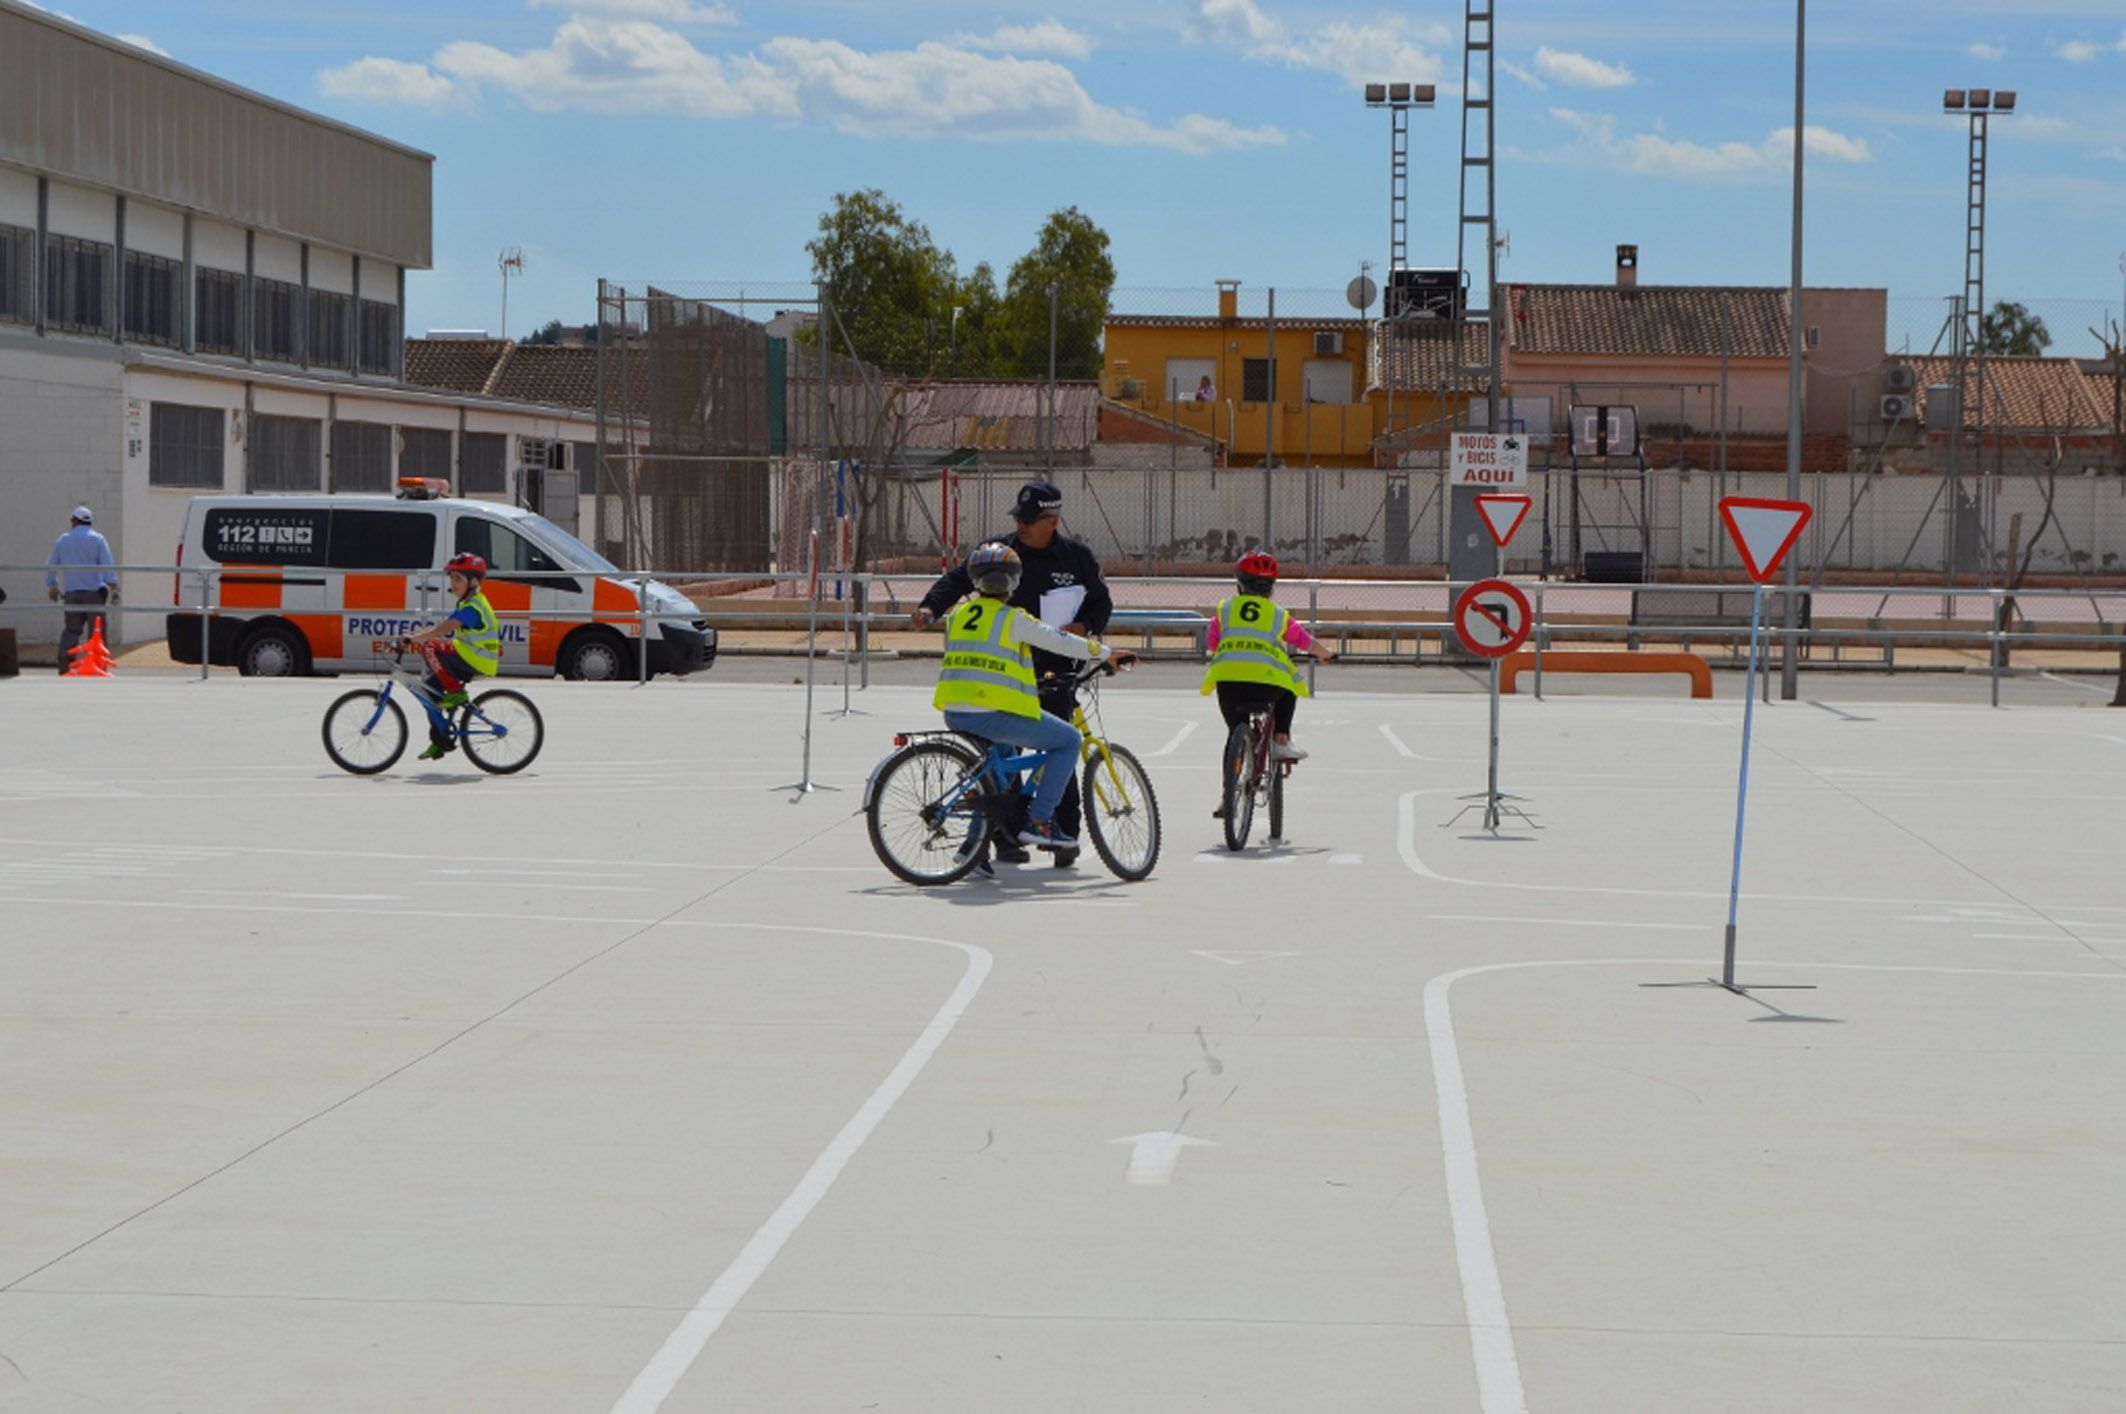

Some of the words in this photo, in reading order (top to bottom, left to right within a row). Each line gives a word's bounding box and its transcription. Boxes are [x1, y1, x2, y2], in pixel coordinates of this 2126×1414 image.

[1459, 435, 1497, 449] MOTOS
[1467, 450, 1496, 465] BICIS
[218, 525, 256, 543] 112
[259, 545, 270, 553] DE
[963, 604, 984, 631] 2
[1240, 601, 1261, 622] 6
